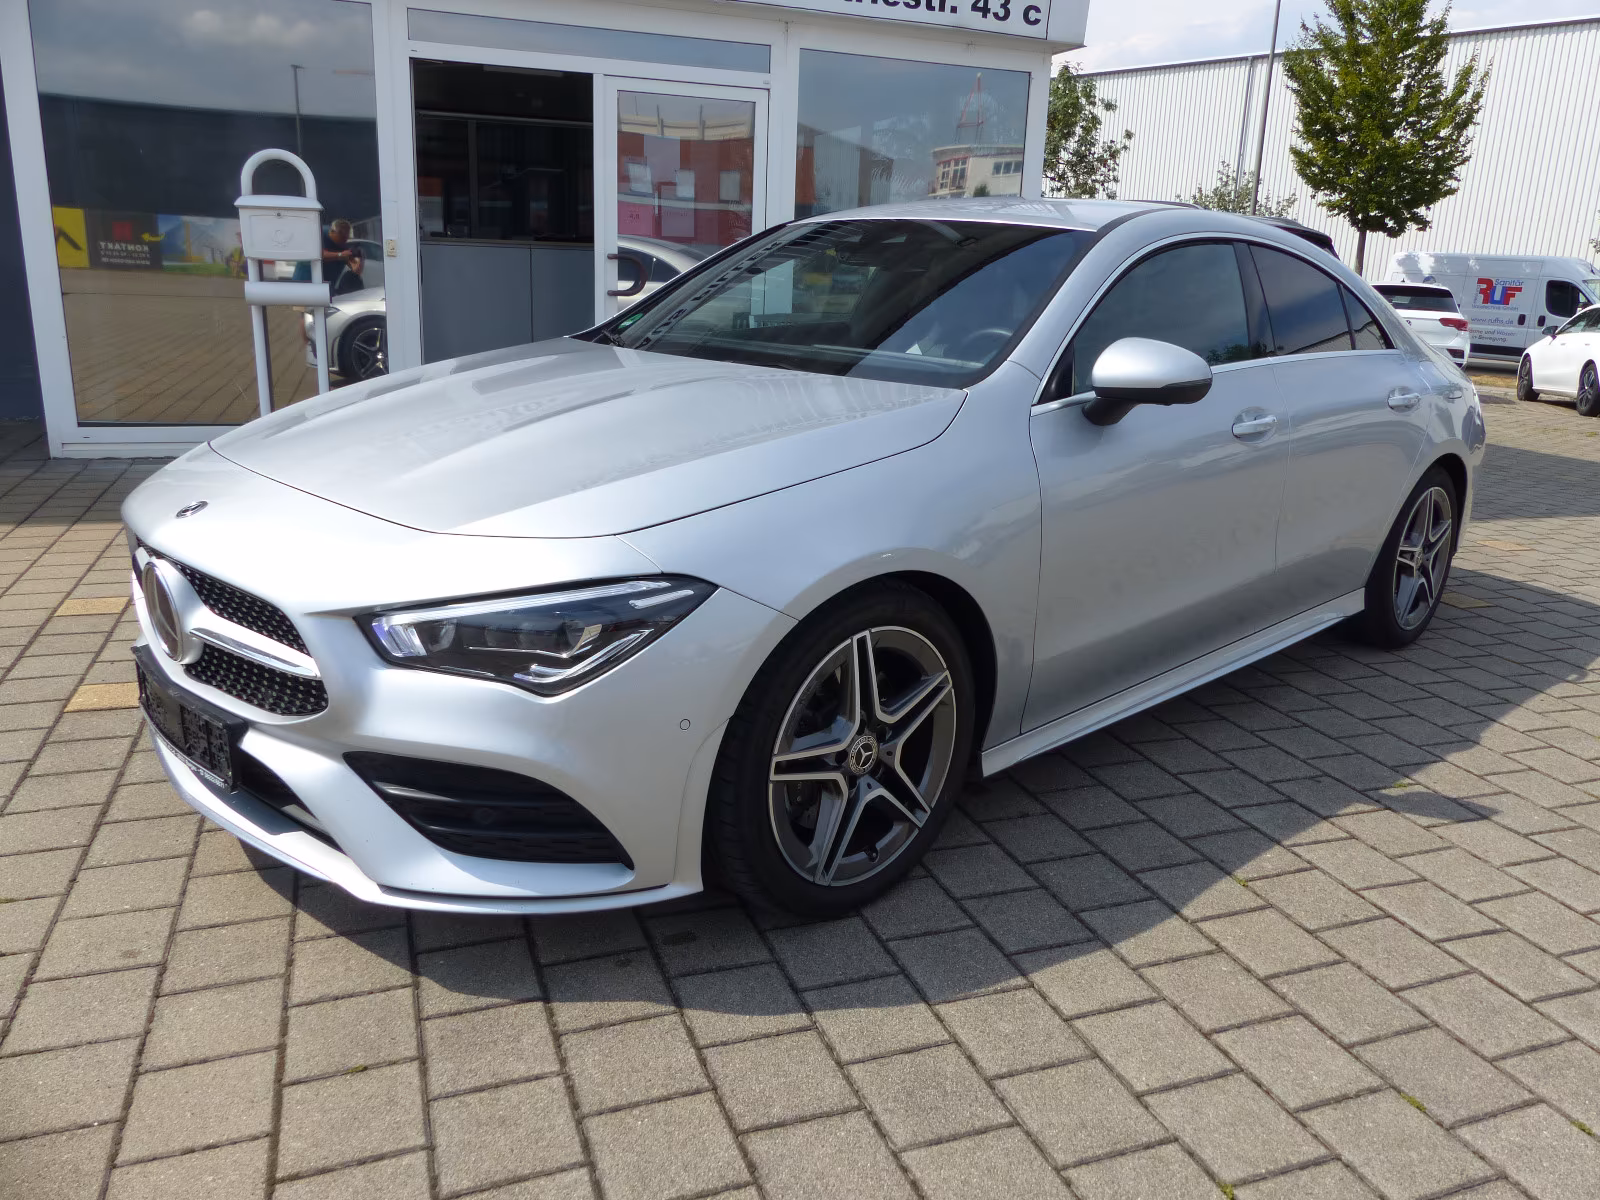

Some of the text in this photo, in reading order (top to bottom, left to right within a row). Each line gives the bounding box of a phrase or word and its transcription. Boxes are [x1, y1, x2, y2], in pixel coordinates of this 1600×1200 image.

[970, 0, 1011, 22] 43
[1022, 4, 1042, 26] c
[1476, 277, 1523, 305] RUF
[1495, 278, 1524, 287] Sanitär
